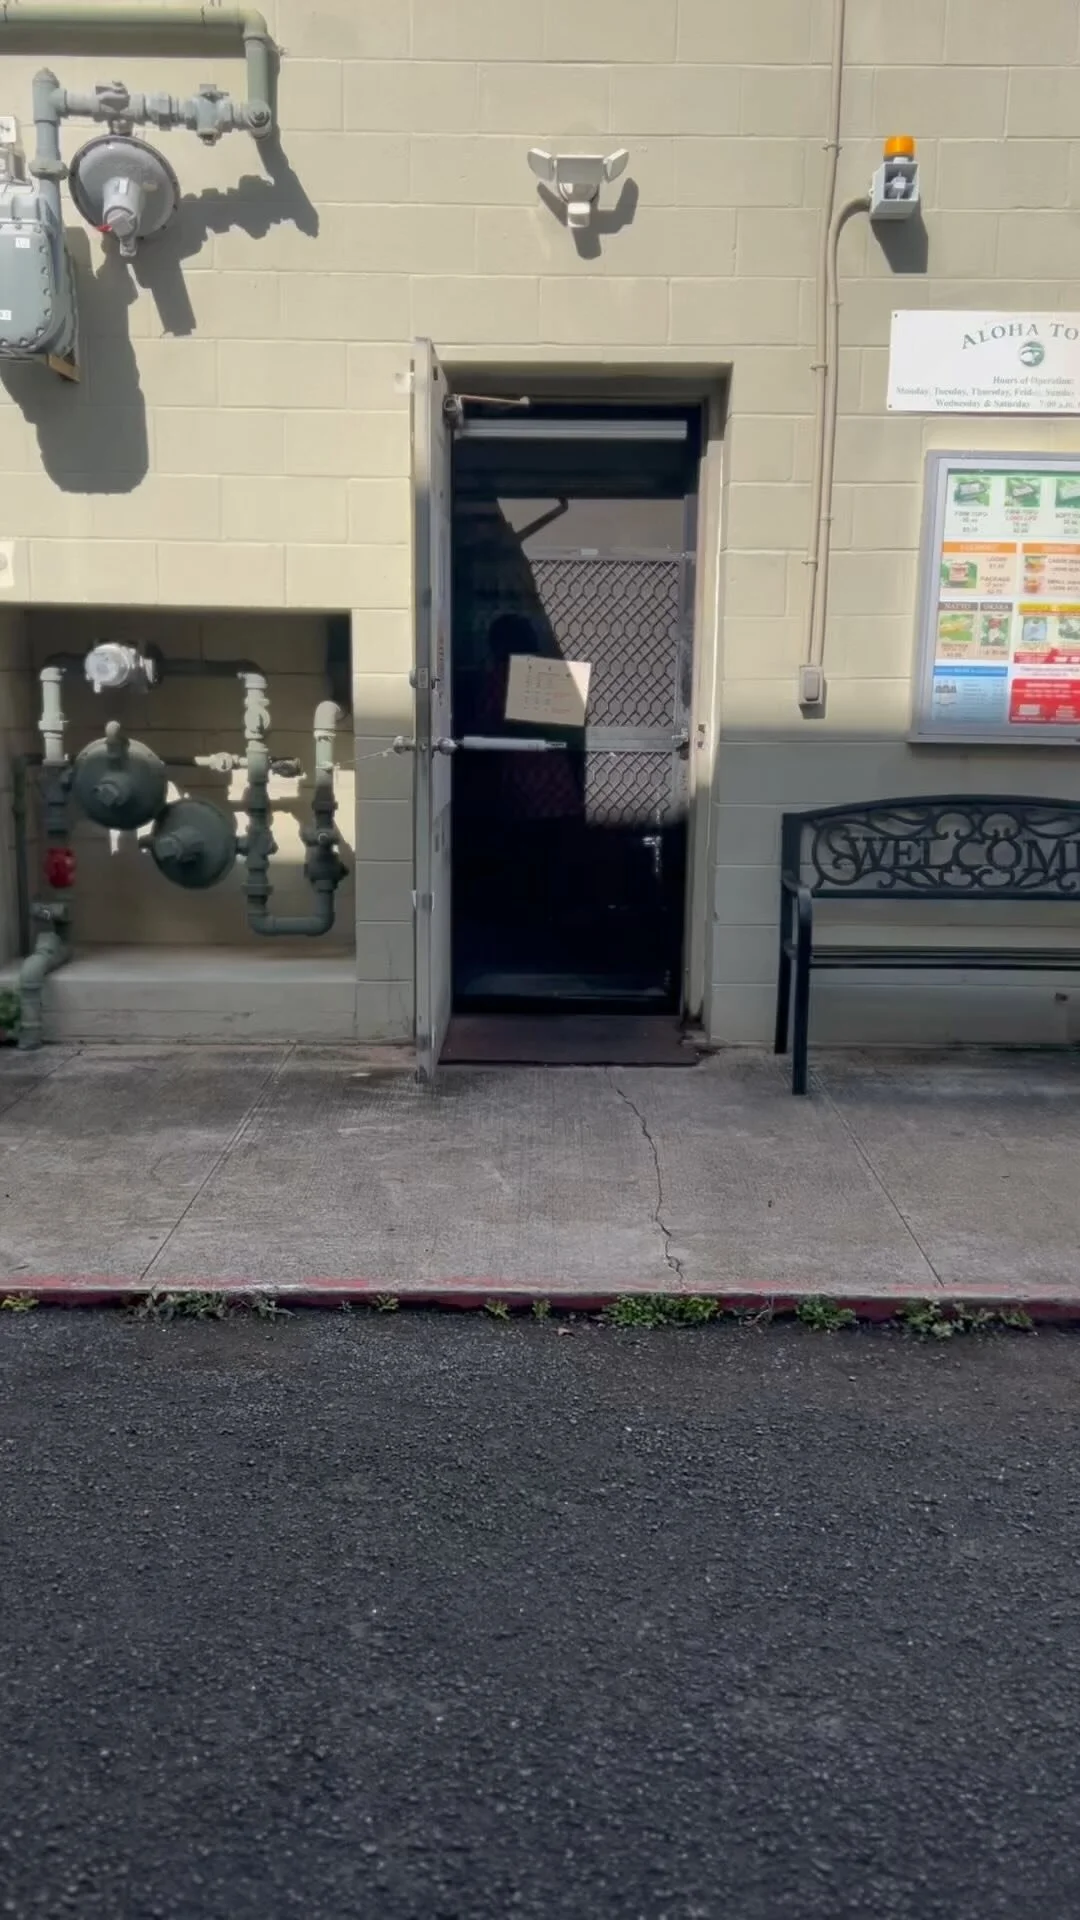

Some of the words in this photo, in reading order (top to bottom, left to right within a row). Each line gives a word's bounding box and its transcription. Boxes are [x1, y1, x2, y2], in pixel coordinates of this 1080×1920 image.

[962, 323, 1039, 349] ALOHA
[1049, 322, 1080, 341] TO
[993, 376, 1017, 384] Hours
[1020, 376, 1029, 384] of
[936, 399, 980, 409] Wednesday
[984, 400, 991, 408] &
[994, 400, 1030, 409] Saturday
